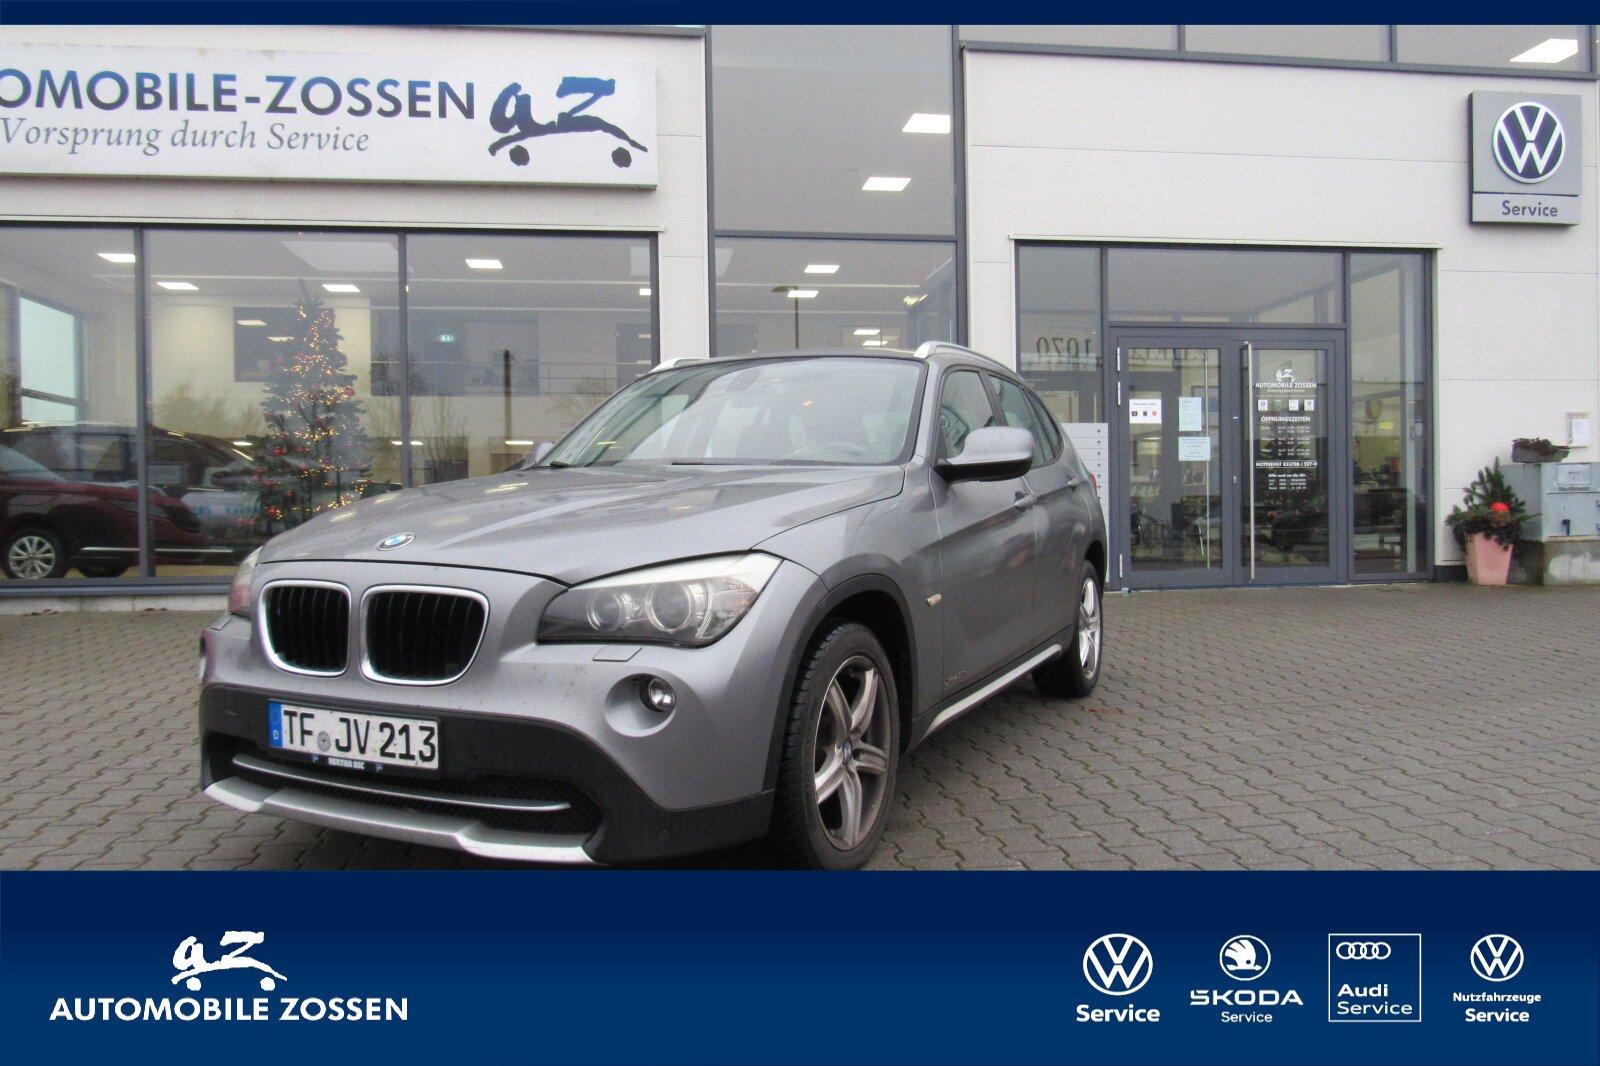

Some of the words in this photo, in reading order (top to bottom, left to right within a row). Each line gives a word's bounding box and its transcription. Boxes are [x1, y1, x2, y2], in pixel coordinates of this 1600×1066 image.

[1, 117, 161, 156] Vorsprung
[171, 119, 256, 149] durch
[267, 122, 370, 152] Service
[1501, 200, 1558, 217] Service
[283, 710, 316, 747] TF
[334, 717, 371, 755] JV
[379, 721, 437, 763] 213
